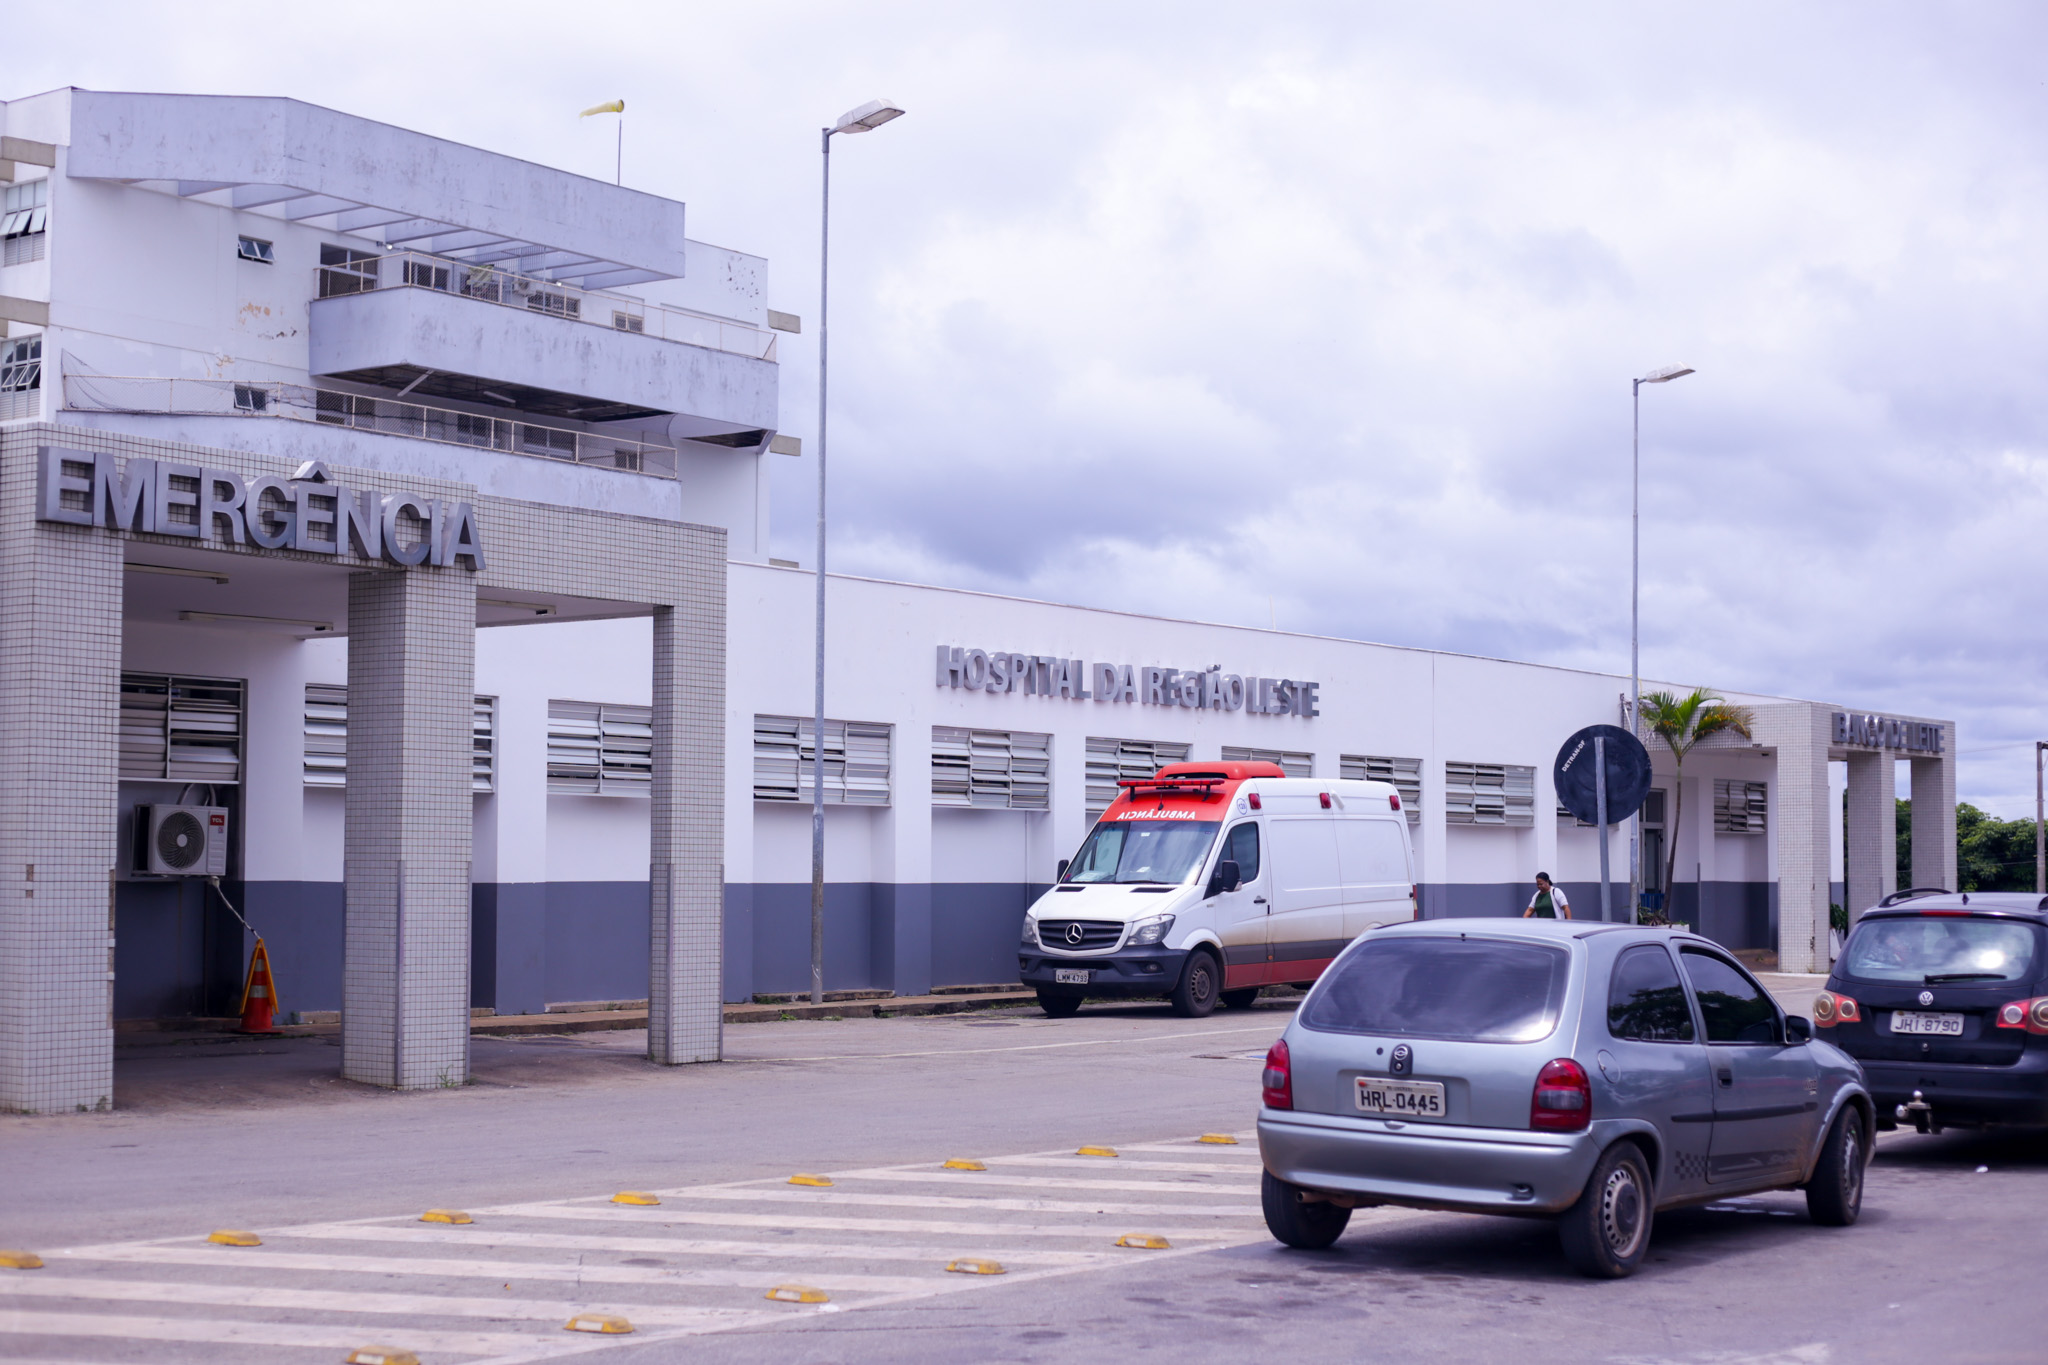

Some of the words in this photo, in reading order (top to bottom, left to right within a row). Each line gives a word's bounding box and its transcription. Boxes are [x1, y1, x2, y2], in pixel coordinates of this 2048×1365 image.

[38, 446, 486, 571] EMERGÊNCIA
[936, 645, 1091, 699] HOSPITAL
[1093, 662, 1138, 703] DA
[1142, 664, 1245, 711] REGIÃO
[1246, 676, 1320, 717] LESTE
[1561, 739, 1586, 772] DETRAN-DF
[1832, 712, 1886, 747] BANCO
[1885, 718, 1907, 749] DE
[1907, 721, 1945, 752] LEITE
